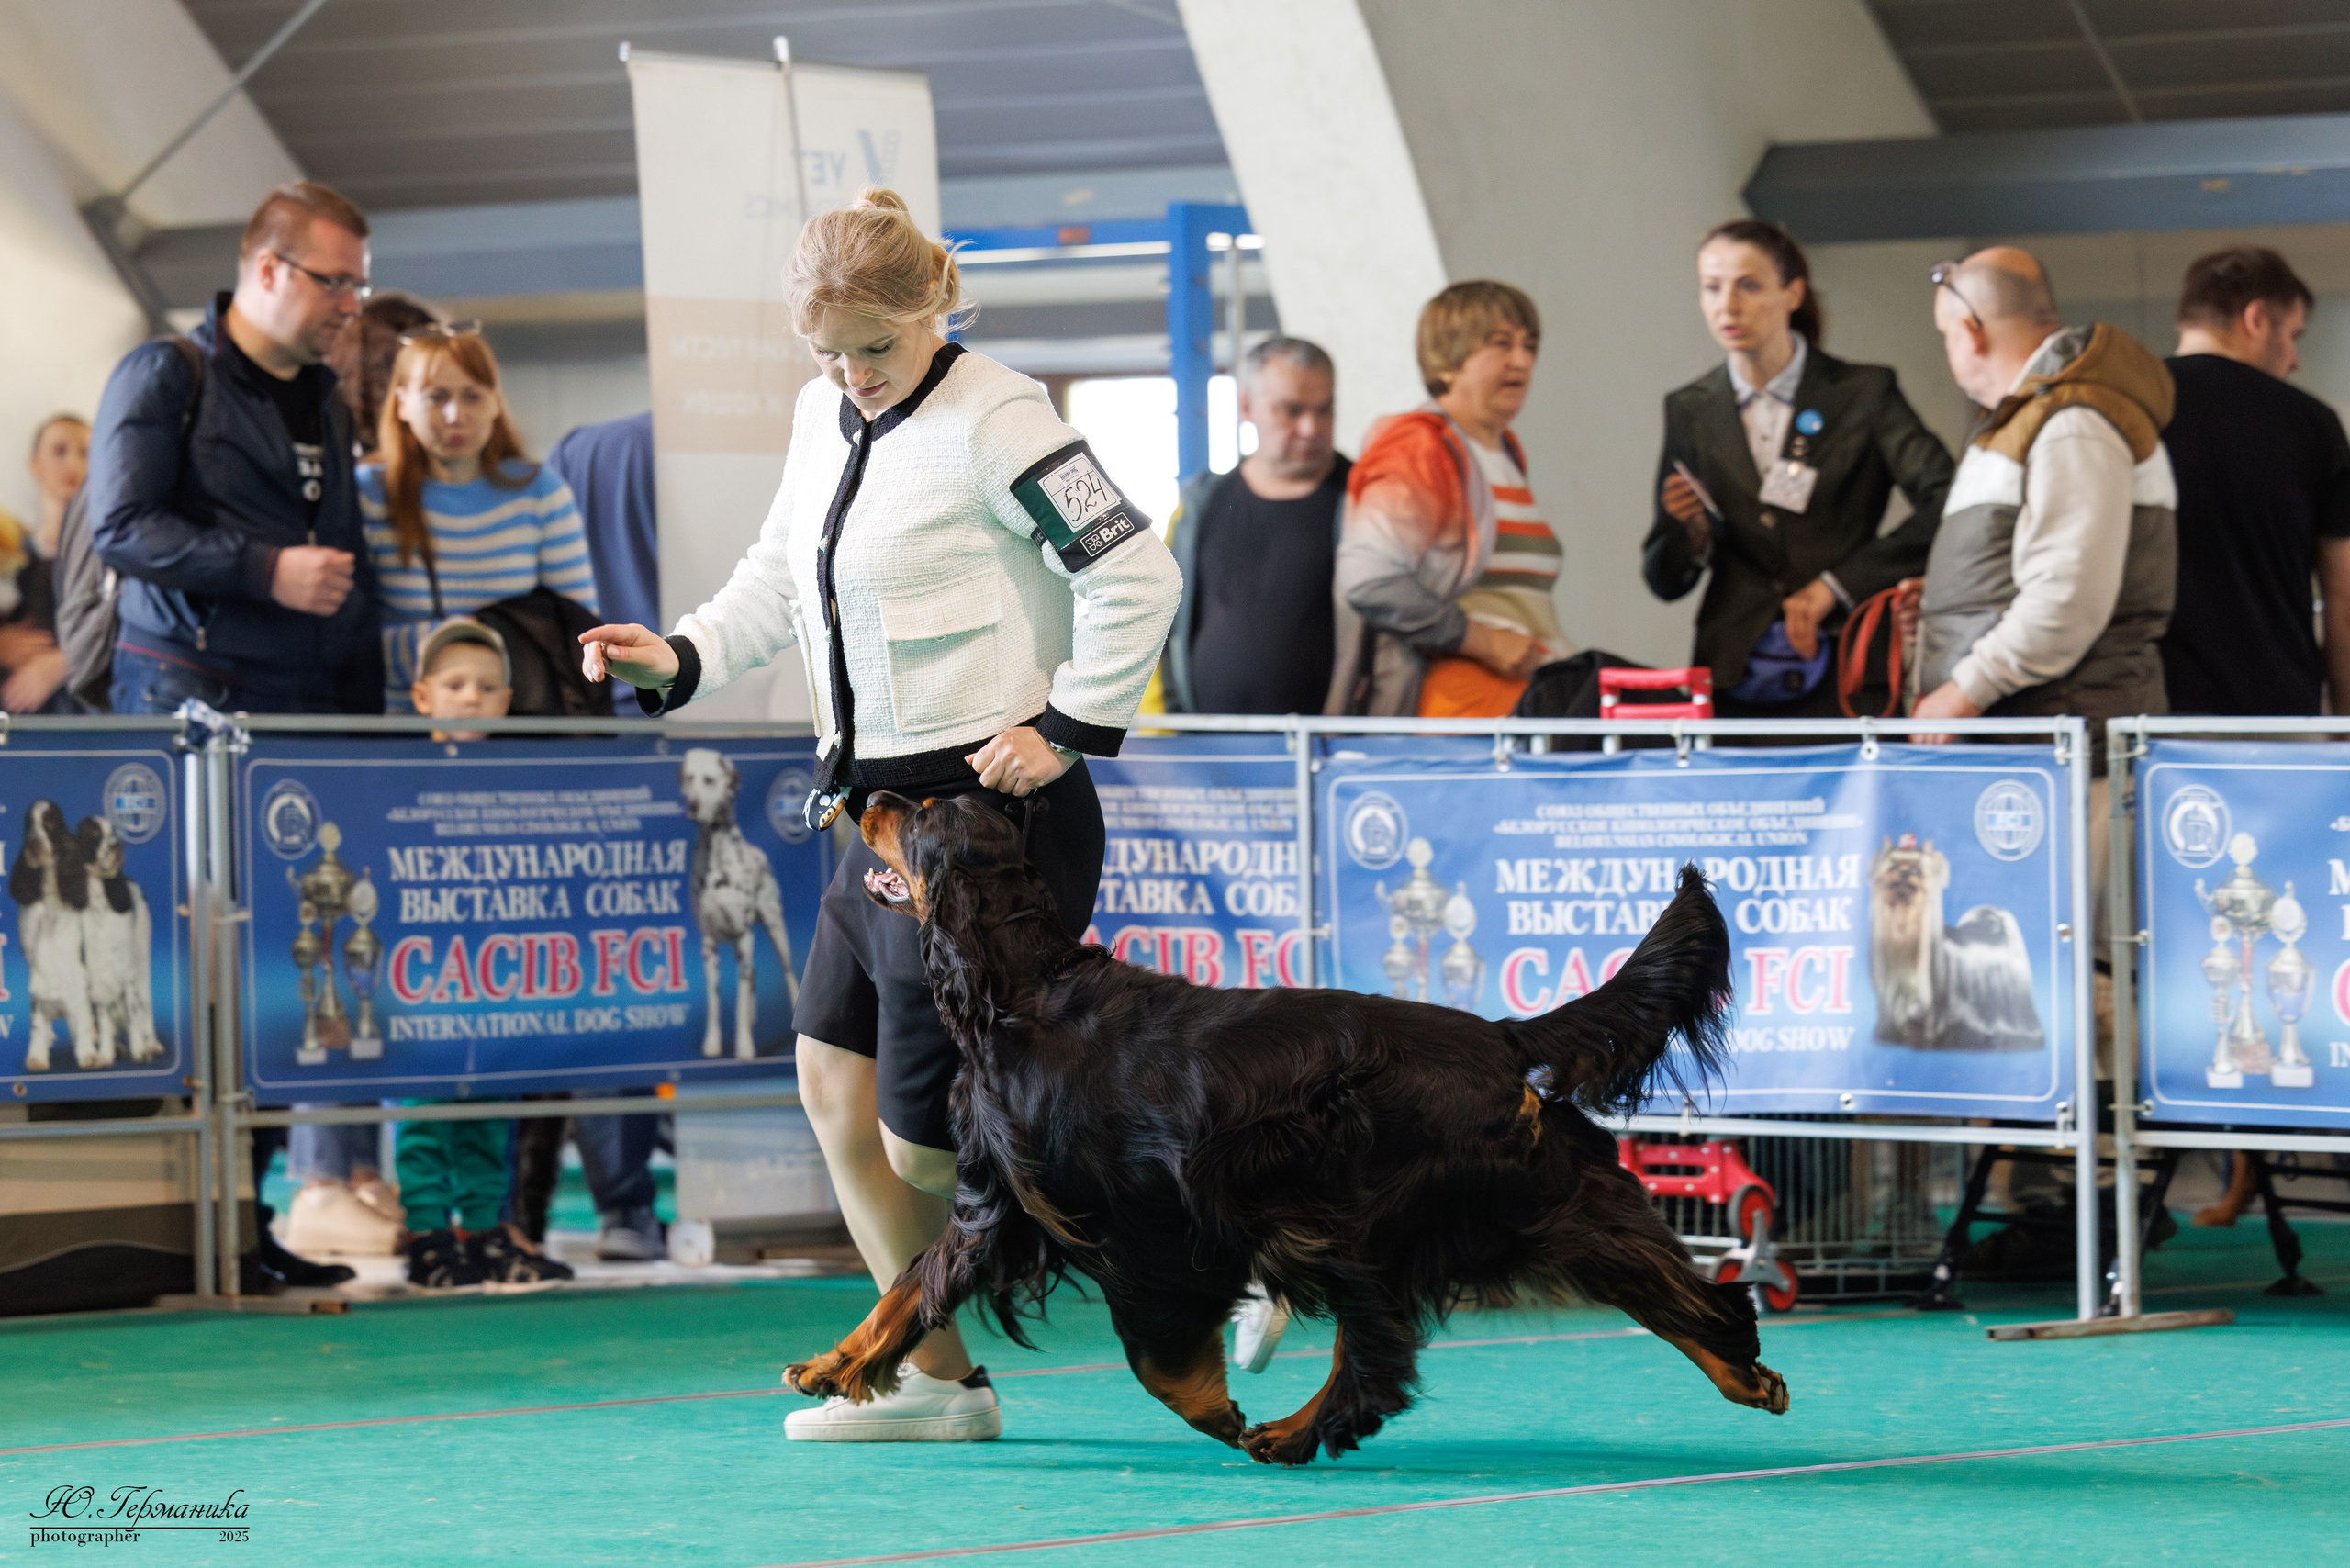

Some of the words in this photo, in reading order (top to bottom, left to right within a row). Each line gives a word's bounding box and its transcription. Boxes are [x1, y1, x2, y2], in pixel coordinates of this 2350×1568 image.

[1064, 472, 1107, 521] 524
[1099, 519, 1130, 543] Brit
[387, 839, 687, 883] МЕЖДУНАРОДНАЯ
[1102, 837, 1299, 880] ДУНАРОДН
[1494, 854, 1862, 898] МЕЖДУНРОДНАЯ
[400, 884, 572, 924] ВЫСТАВКА
[585, 879, 682, 917] СОБАК
[1094, 879, 1215, 915] ТАВКА
[1225, 879, 1302, 917] СОБ
[1507, 898, 1672, 935] ВЫСТАВ
[1735, 897, 1852, 935] СОБАК
[388, 930, 583, 1005] CACIB
[589, 926, 688, 997] FCI
[1744, 946, 1855, 1015] FCI
[389, 1011, 571, 1041] INTERNATIONAL
[574, 1007, 621, 1035] DOG
[624, 1003, 688, 1030] SHOW
[1777, 1026, 1855, 1053] SHOW
